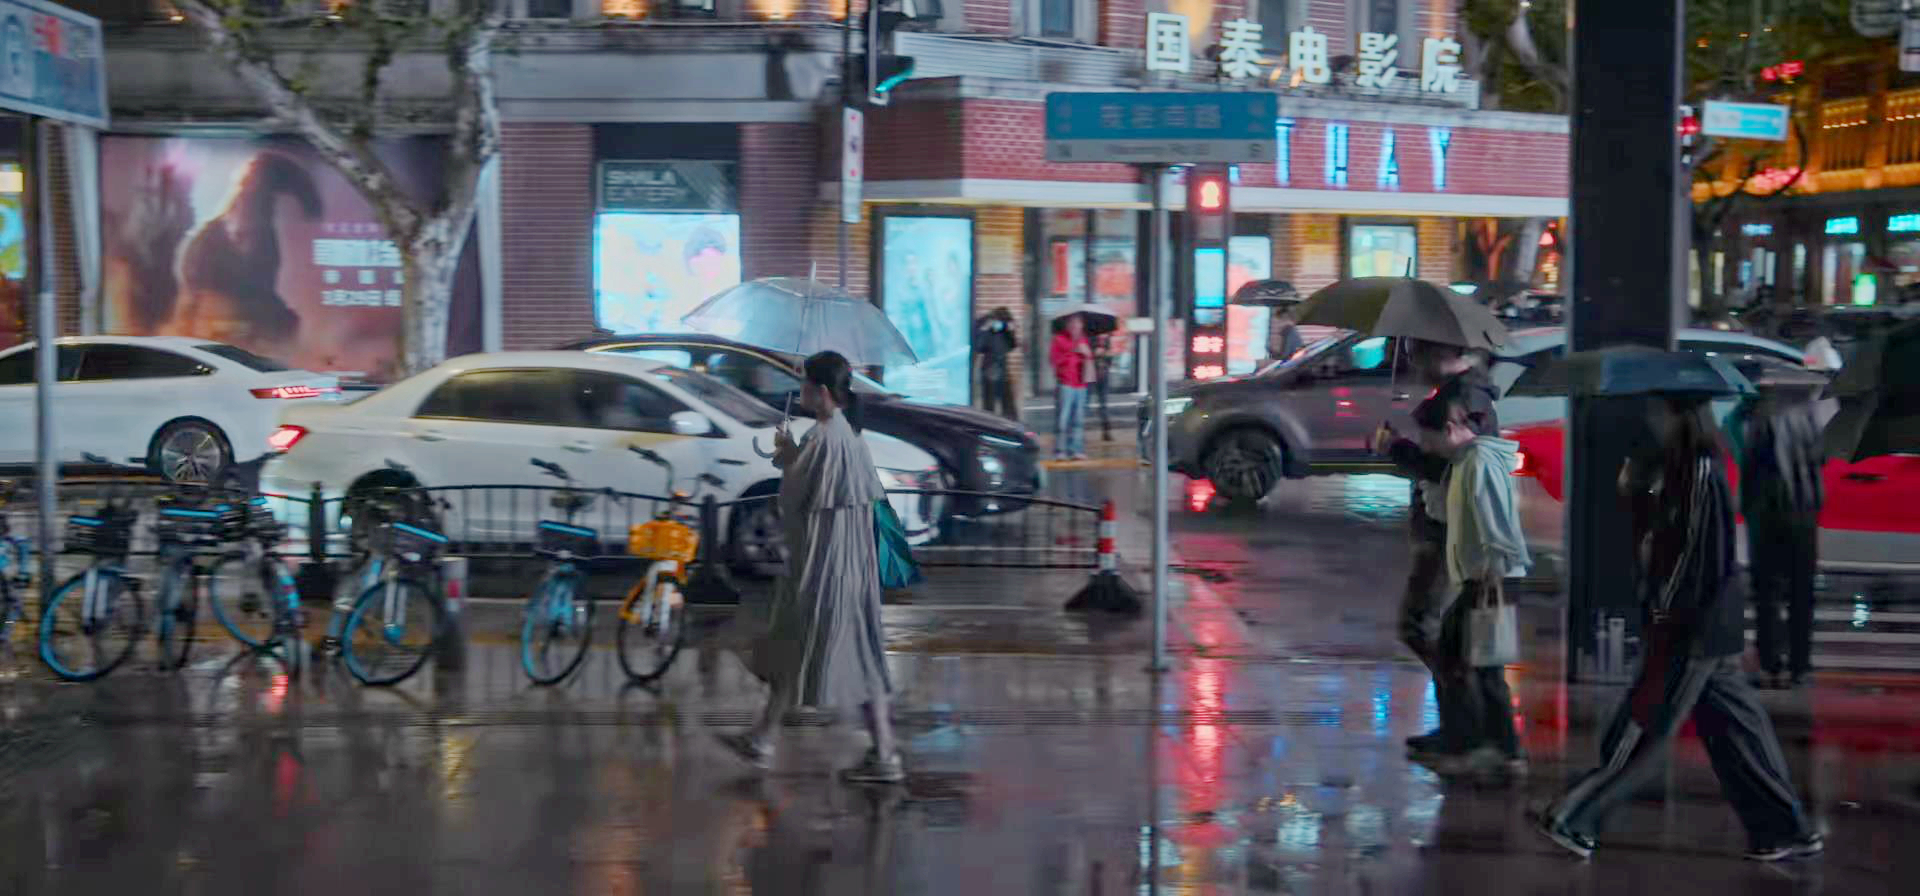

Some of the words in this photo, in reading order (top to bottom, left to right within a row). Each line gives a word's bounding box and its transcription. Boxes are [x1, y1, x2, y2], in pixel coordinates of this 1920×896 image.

[1146, 12, 1462, 92] 国泰电影院
